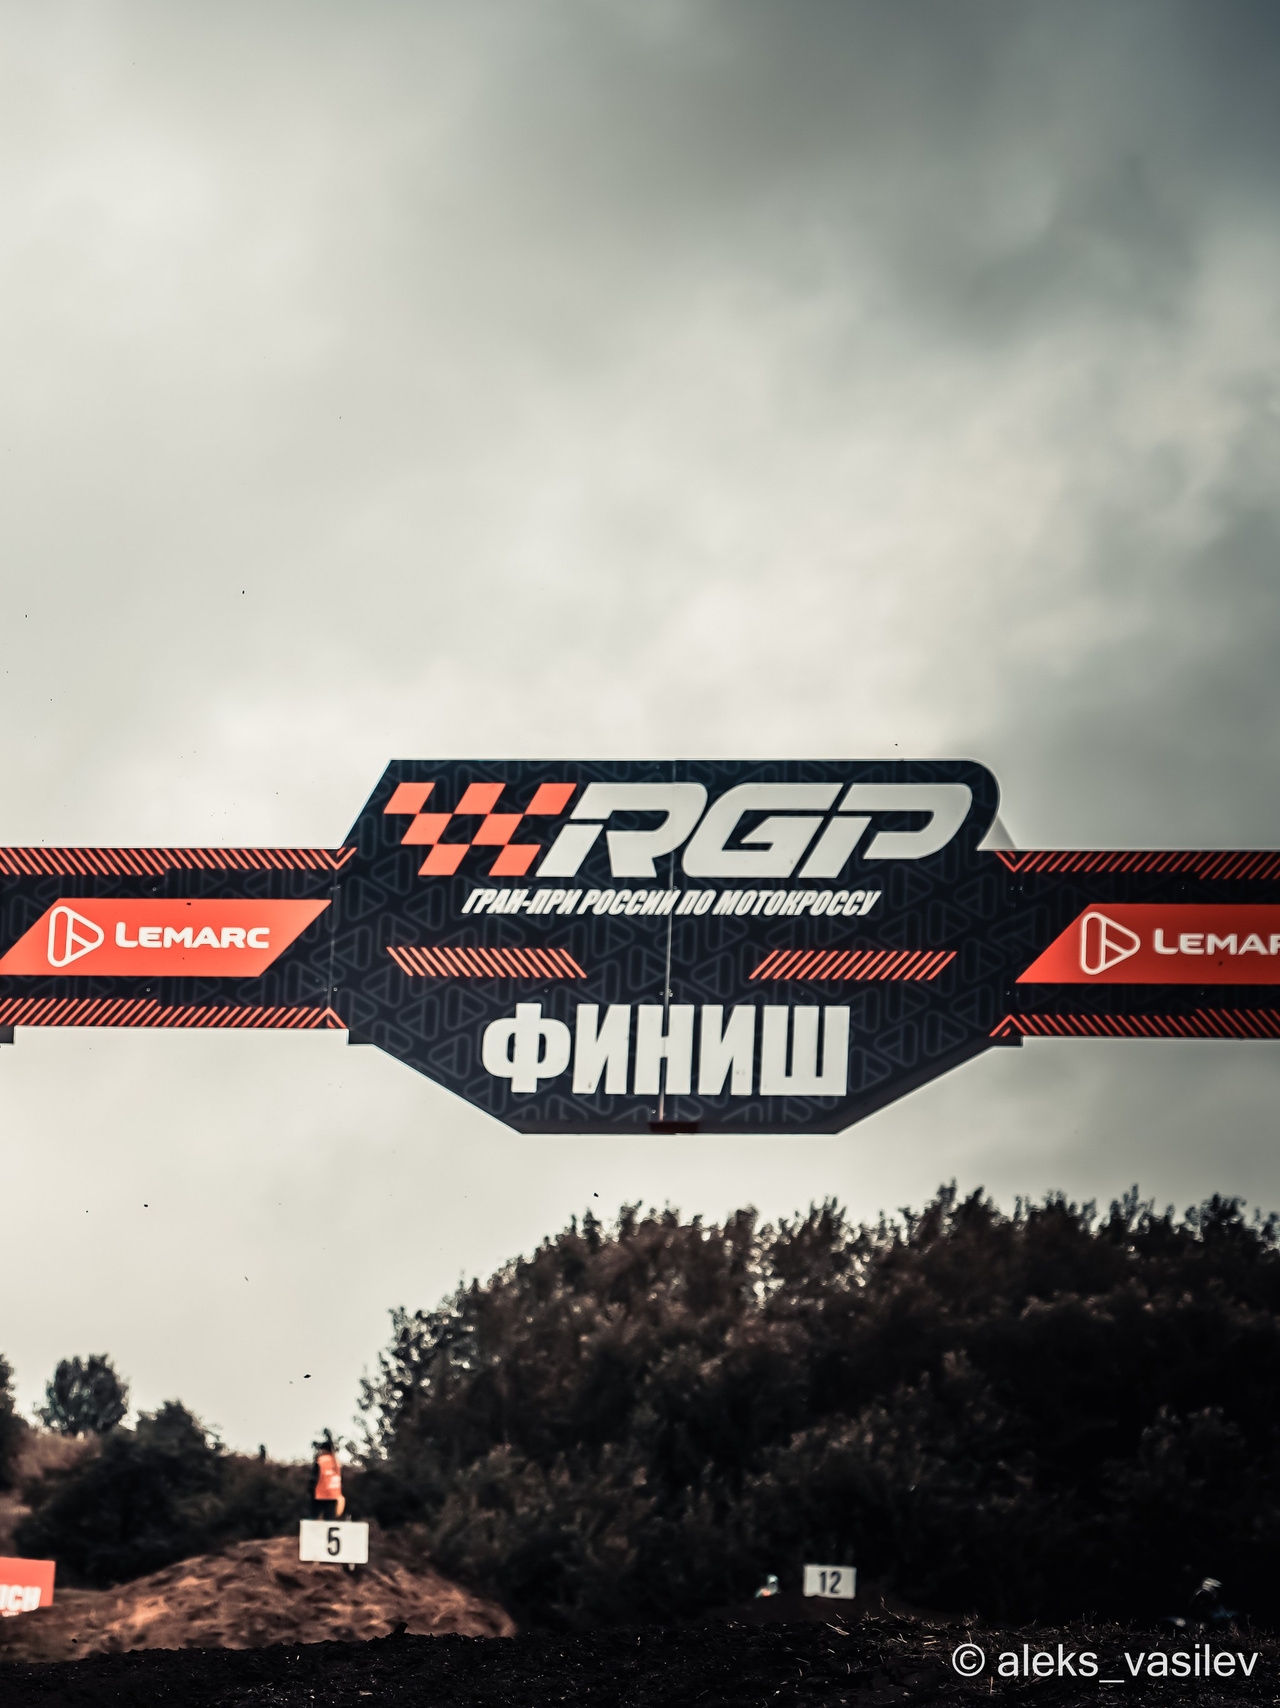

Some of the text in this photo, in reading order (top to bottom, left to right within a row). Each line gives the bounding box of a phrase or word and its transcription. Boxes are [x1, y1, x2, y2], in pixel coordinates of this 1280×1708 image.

[536, 782, 973, 878] RGP
[461, 887, 882, 917] ГРАН-ПРИ РОССИИ ПО МОТОКРОССУ
[115, 922, 270, 949] LEMARC
[482, 1002, 851, 1096] ФИНИШ
[327, 1526, 340, 1556] 5
[819, 1570, 842, 1594] 12
